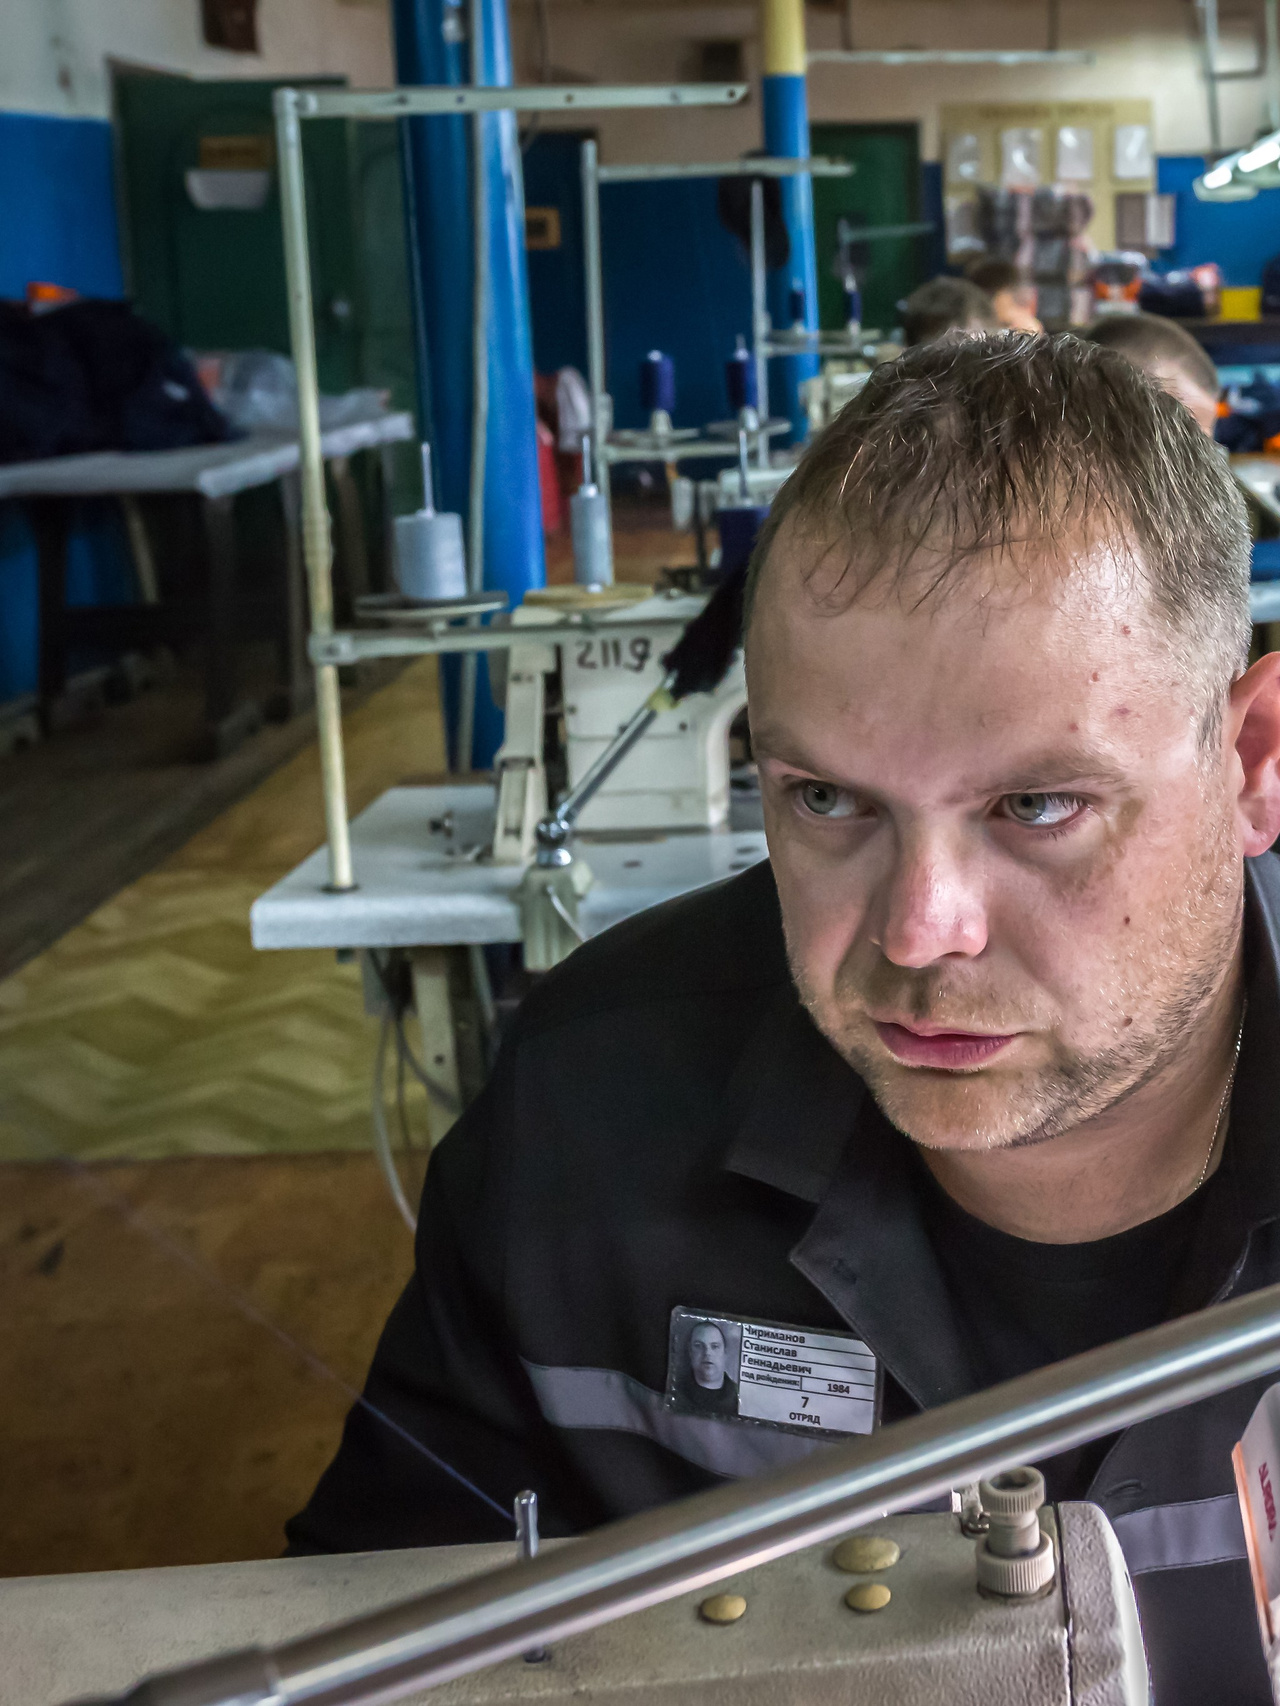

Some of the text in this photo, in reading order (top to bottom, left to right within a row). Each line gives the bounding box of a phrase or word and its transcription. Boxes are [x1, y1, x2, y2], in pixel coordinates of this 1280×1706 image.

[576, 636, 651, 673] 2119
[743, 1339, 798, 1358] Станислав
[742, 1354, 812, 1375] Геннадьевич
[741, 1371, 755, 1381] год
[827, 1383, 850, 1395] 1984
[801, 1396, 810, 1408] 7
[788, 1412, 821, 1426] ОТРЯД
